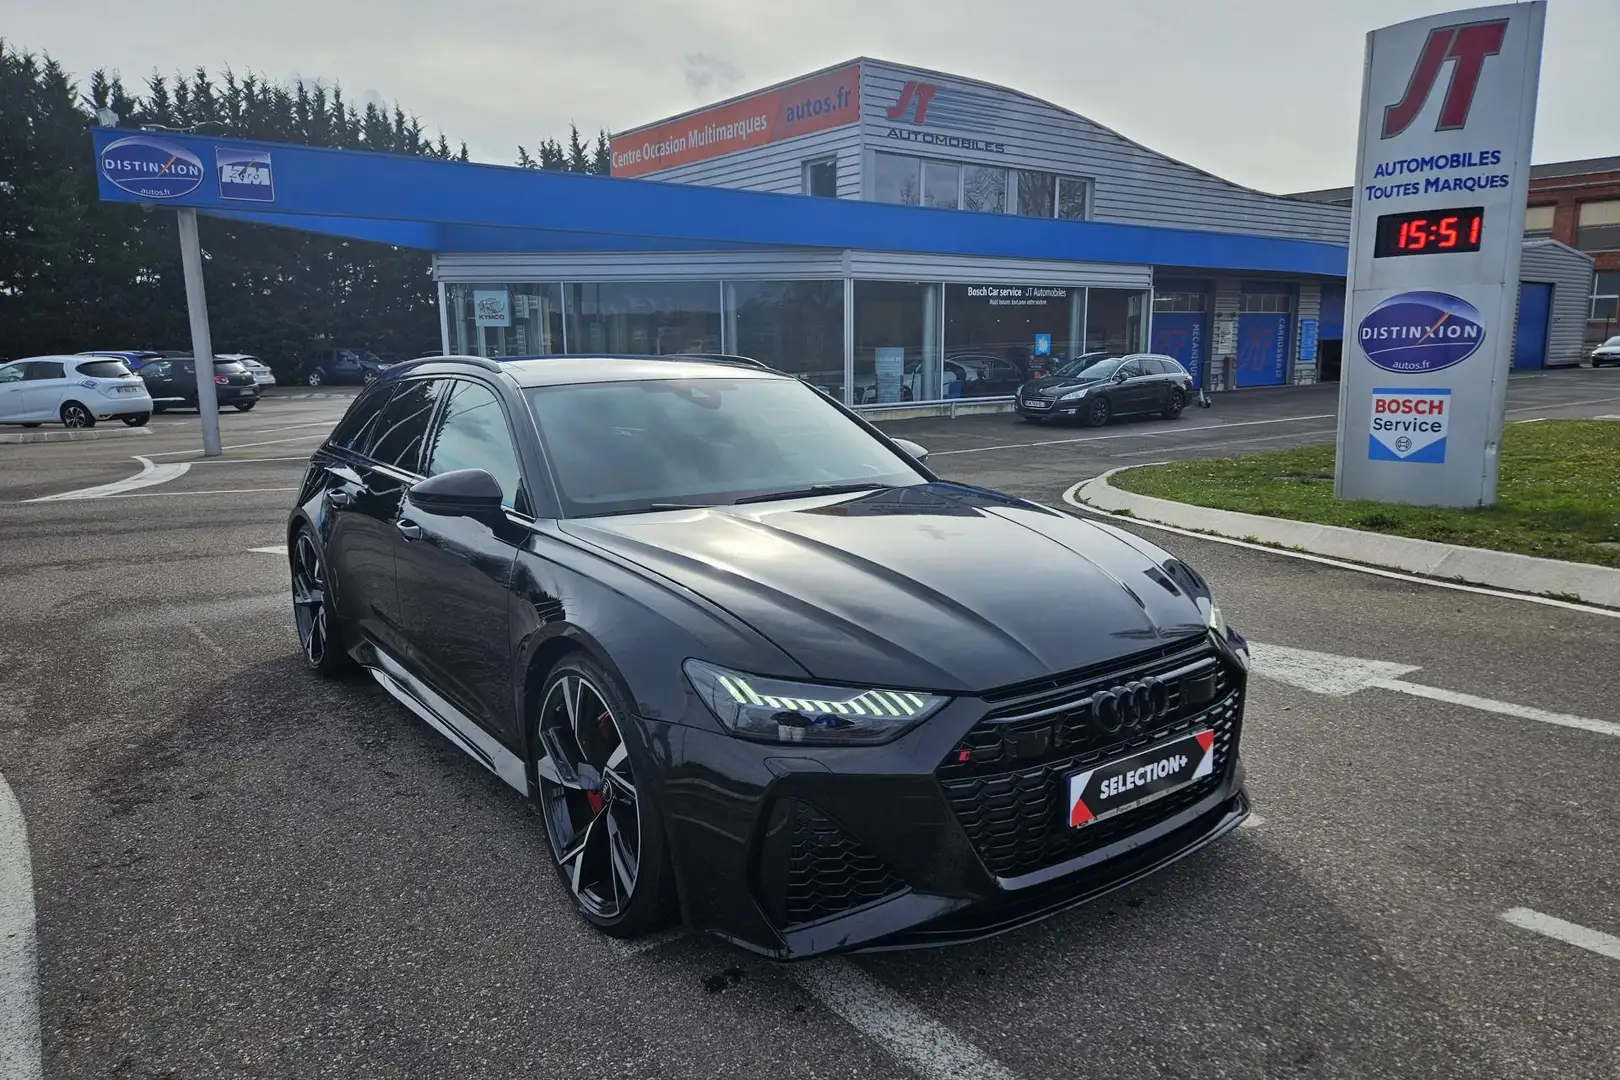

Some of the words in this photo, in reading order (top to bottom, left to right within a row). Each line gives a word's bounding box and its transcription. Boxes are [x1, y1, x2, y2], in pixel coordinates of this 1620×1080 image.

[1381, 18, 1510, 140] JT
[787, 85, 851, 123] autos.fr
[886, 80, 937, 126] JT
[612, 149, 641, 169] Centre
[643, 136, 686, 161] Occasion
[688, 114, 767, 149] Multimarques
[887, 128, 1005, 153] AUTOMOBILES
[104, 156, 199, 176] DISTINXION
[1374, 150, 1501, 178] AUTOMOBILES
[141, 187, 171, 196] autos.fr
[1398, 215, 1481, 250] 15:51
[968, 286, 987, 296] Bosch
[988, 286, 999, 296] Car
[1000, 286, 1022, 296] service
[1025, 287, 1033, 297] JT
[1033, 287, 1067, 298] Automobiles
[1361, 320, 1479, 342] DISTINXION
[1392, 360, 1430, 370] autos.fr
[1374, 398, 1444, 415] BOSCH
[1372, 417, 1442, 433] Service
[1099, 754, 1188, 799] SELECTION+
